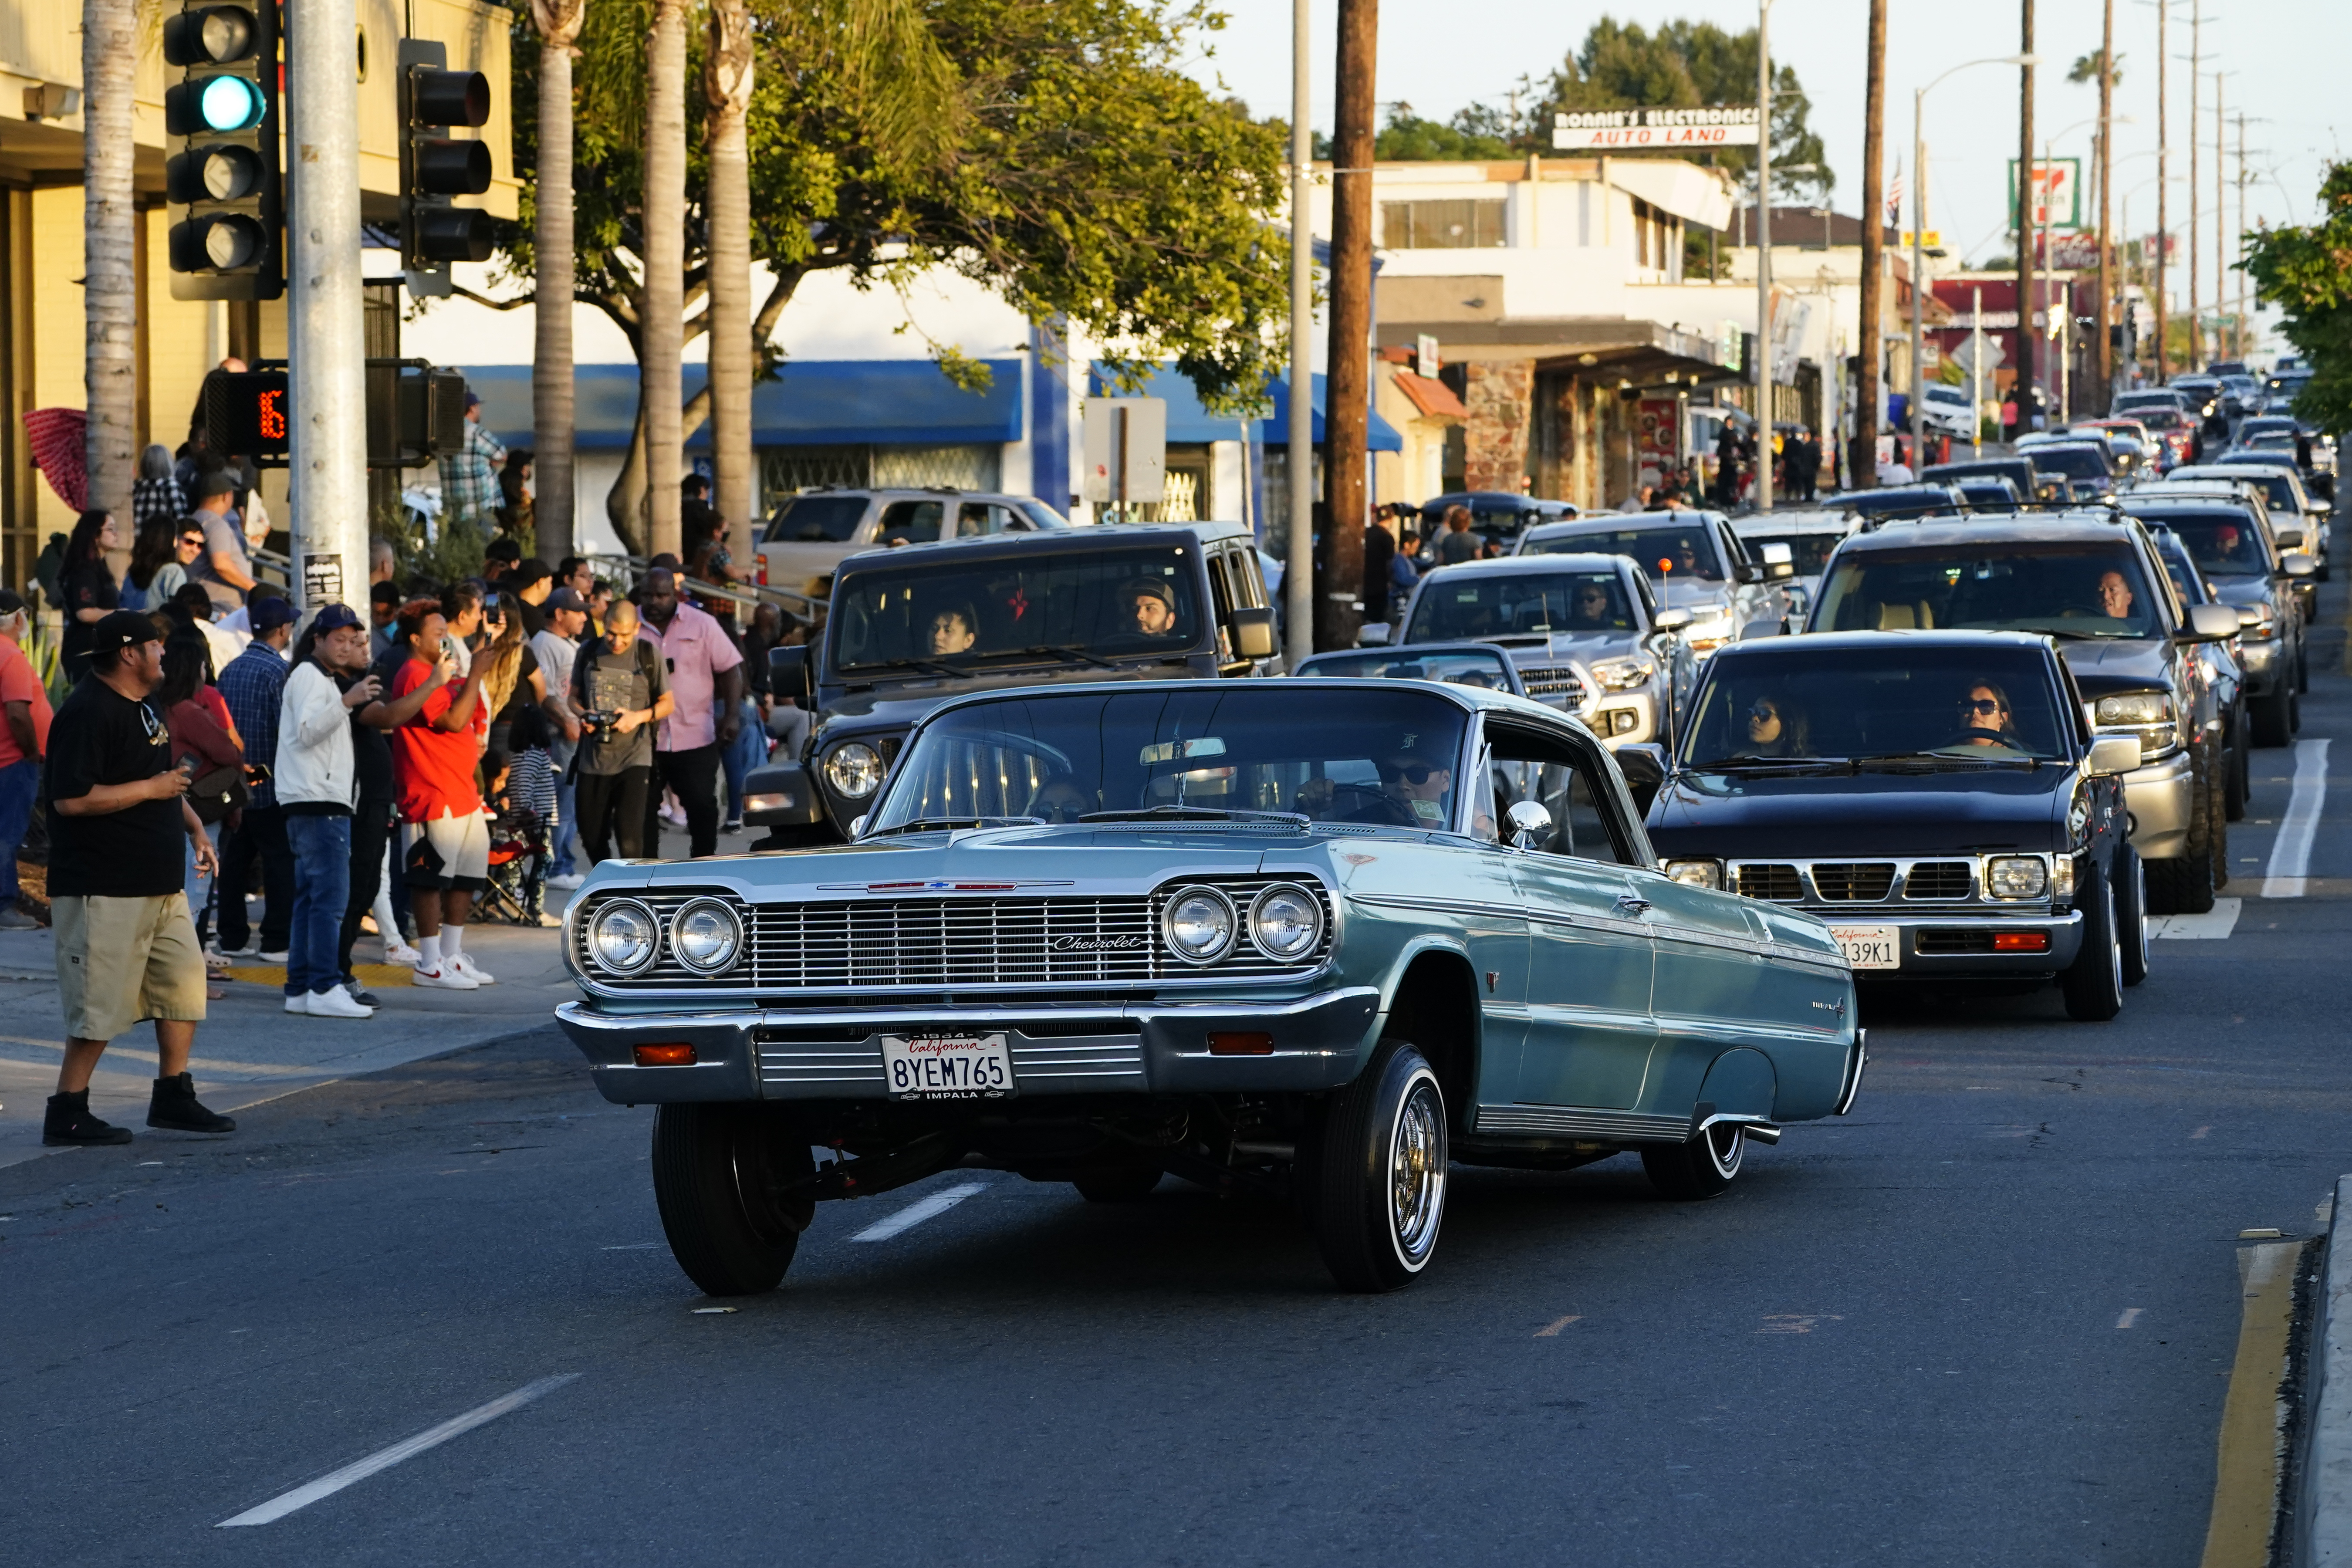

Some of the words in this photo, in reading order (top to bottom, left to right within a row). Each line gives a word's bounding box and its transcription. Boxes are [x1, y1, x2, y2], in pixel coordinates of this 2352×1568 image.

[1646, 108, 1760, 126] ELECTRONICS
[1592, 131, 1650, 143] AUTO
[1666, 129, 1725, 142] LAND
[1053, 936, 1143, 950] Chevrolet
[1832, 929, 1882, 941] California
[1842, 943, 1892, 962] 139K1
[909, 1039, 986, 1056] California
[894, 1057, 1004, 1088] 8YEM765
